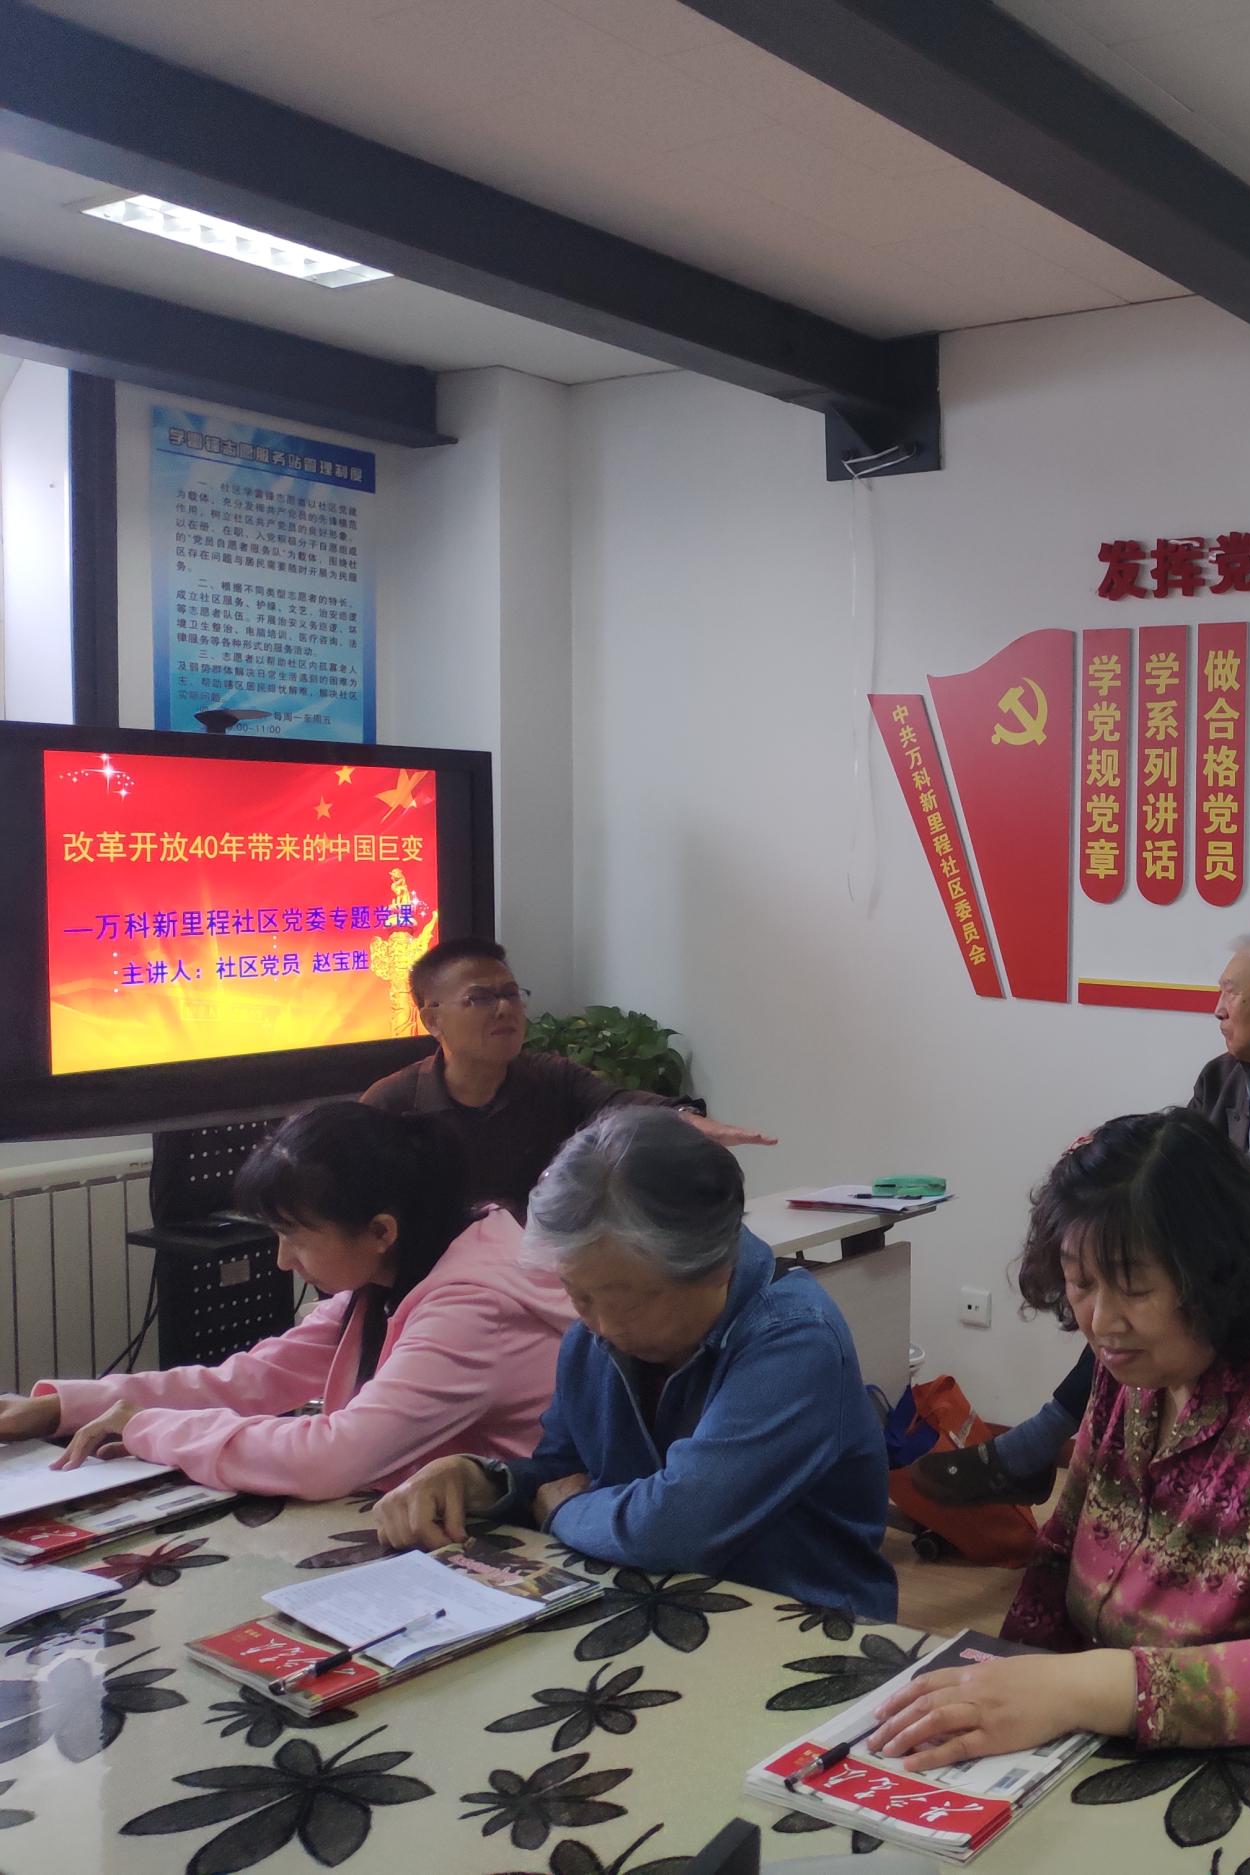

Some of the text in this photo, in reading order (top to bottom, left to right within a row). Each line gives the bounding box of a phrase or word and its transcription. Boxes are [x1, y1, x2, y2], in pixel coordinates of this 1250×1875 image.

[63, 831, 424, 863] 改革开放40年带来的中国巨变
[892, 704, 986, 966] 中共万科新里程社区委员会
[1085, 655, 1121, 879] 学党规党章
[1142, 652, 1179, 880] 学系列讲话
[1203, 649, 1241, 881] 做合格党员
[312, 950, 368, 974] 赵宝胜
